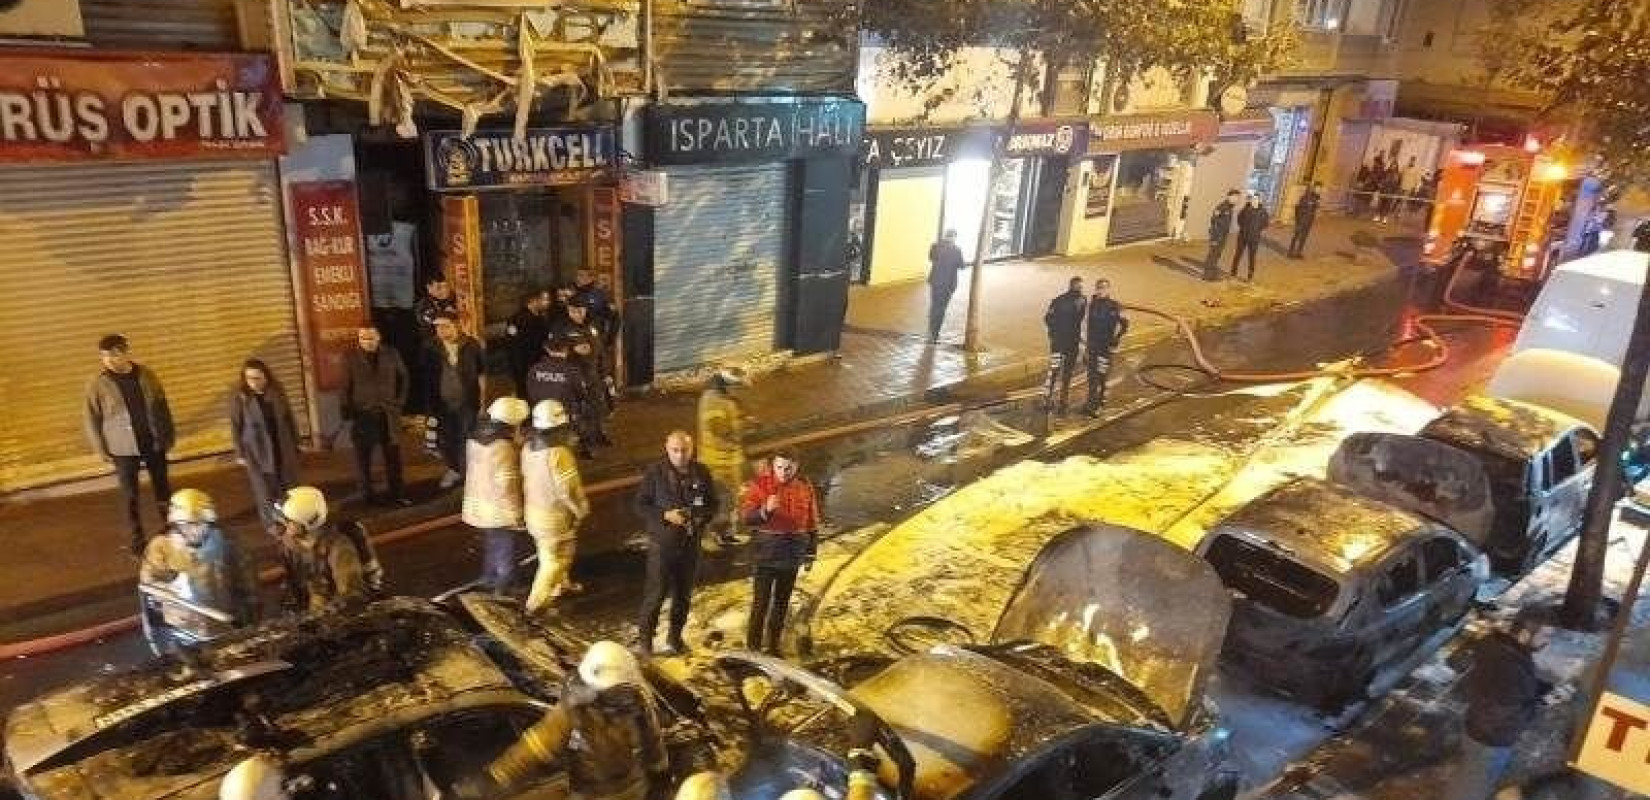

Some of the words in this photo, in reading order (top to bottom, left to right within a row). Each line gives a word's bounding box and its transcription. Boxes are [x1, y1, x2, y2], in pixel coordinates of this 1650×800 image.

[0, 76, 109, 151] RÜŞ
[122, 78, 268, 140] OPTİK
[475, 133, 606, 172] TURKCELL
[671, 117, 783, 151] ISPARTA
